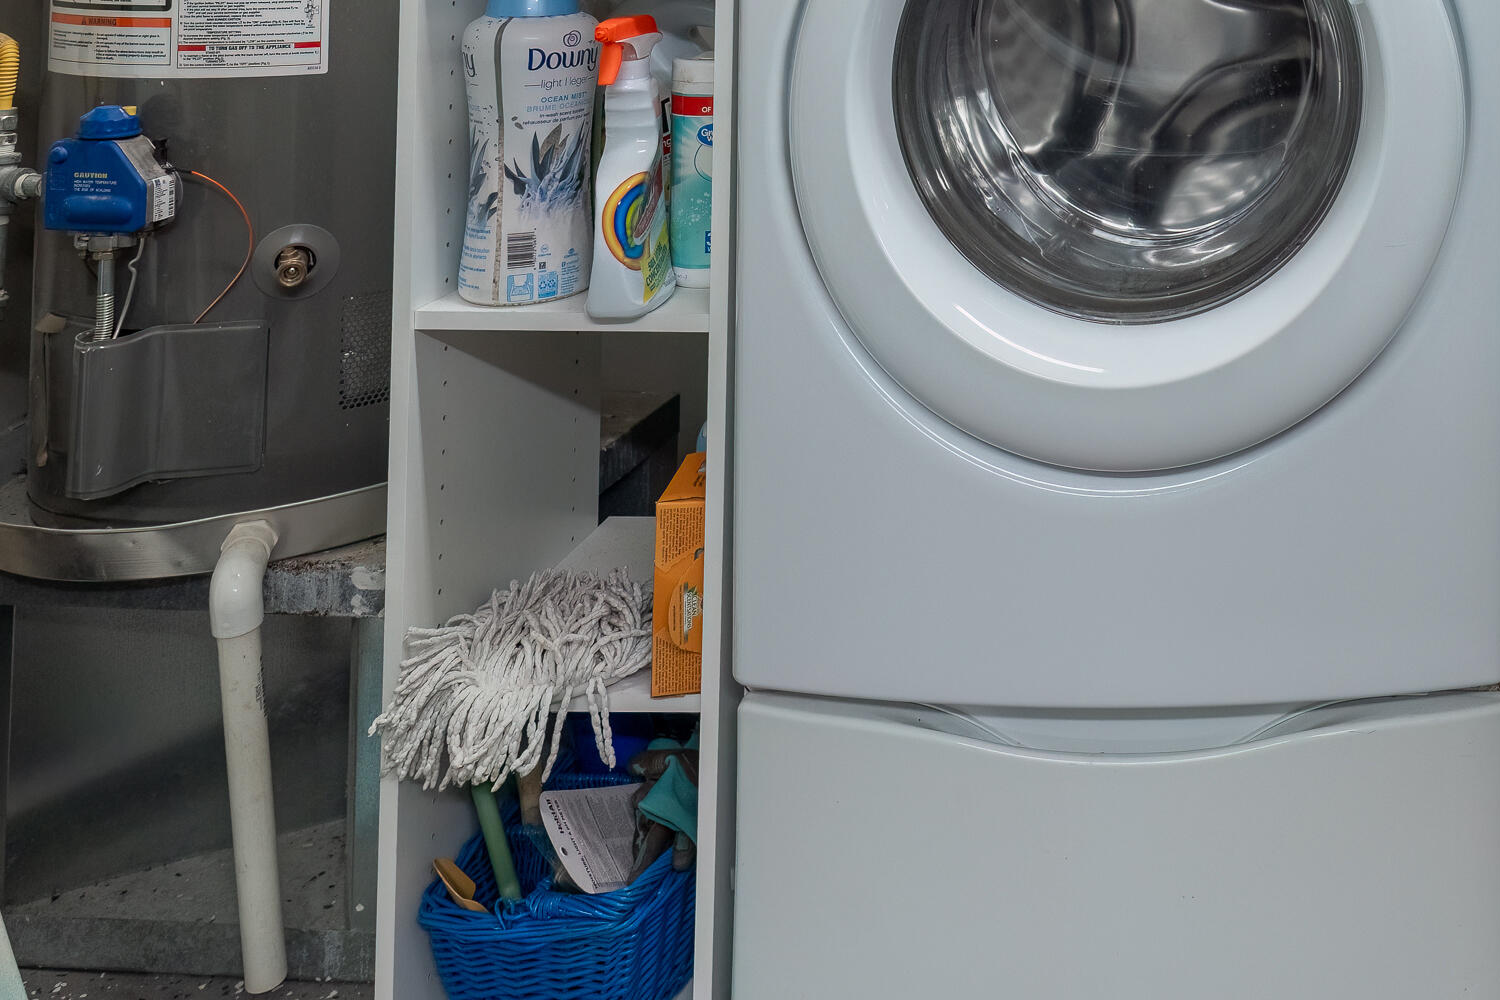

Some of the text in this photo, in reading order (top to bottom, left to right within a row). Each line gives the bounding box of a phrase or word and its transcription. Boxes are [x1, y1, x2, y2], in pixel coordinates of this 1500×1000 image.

[528, 46, 598, 72] Downy
[540, 79, 562, 90] light
[540, 94, 568, 104] OCEAN
[526, 104, 557, 113] BRUME
[554, 800, 566, 820] METER
[570, 837, 582, 856] LIGHT
